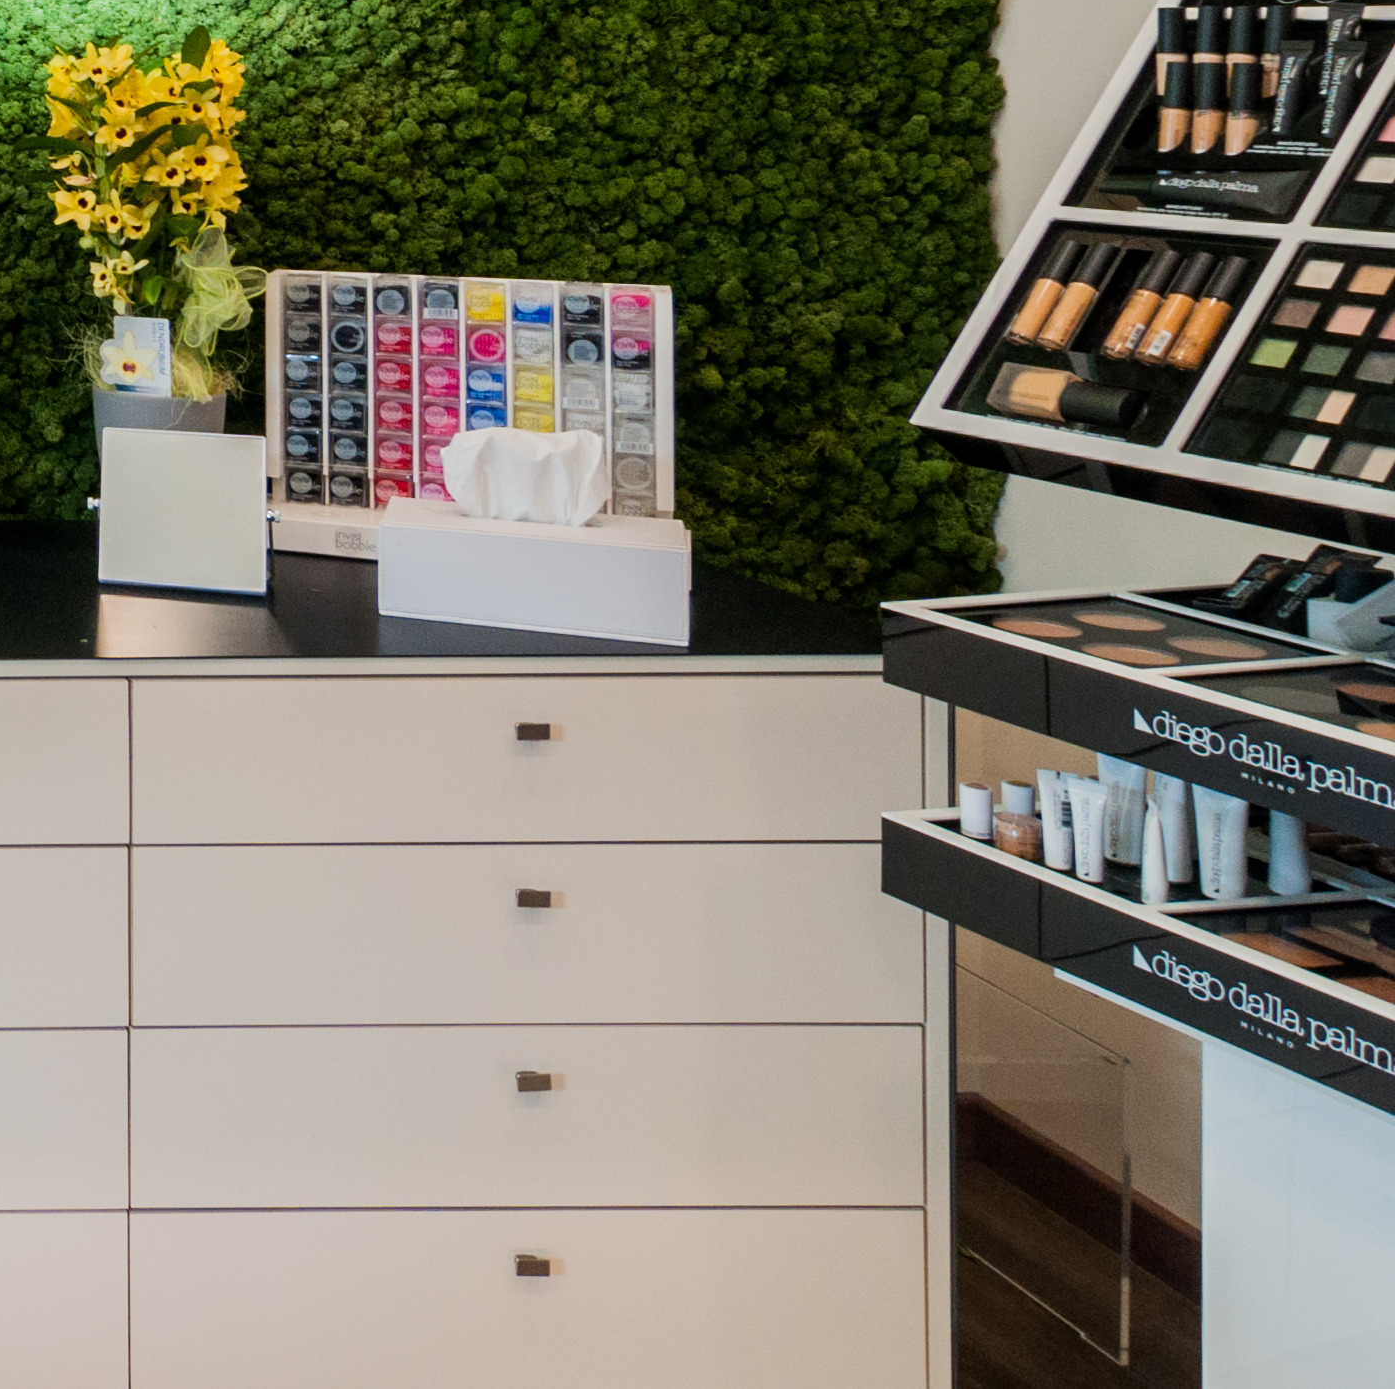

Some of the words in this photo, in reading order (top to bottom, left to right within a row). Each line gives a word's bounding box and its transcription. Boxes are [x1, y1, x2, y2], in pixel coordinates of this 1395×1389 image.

[335, 539, 377, 552] bobble
[1152, 710, 1225, 757] diego
[1229, 733, 1305, 781] dalla
[1306, 760, 1395, 810] palm
[1240, 771, 1296, 795] MILANO
[1152, 950, 1225, 1002] diego
[1228, 982, 1305, 1037] dalla
[1305, 1017, 1395, 1076] palm
[1239, 1020, 1295, 1049] MILANO
